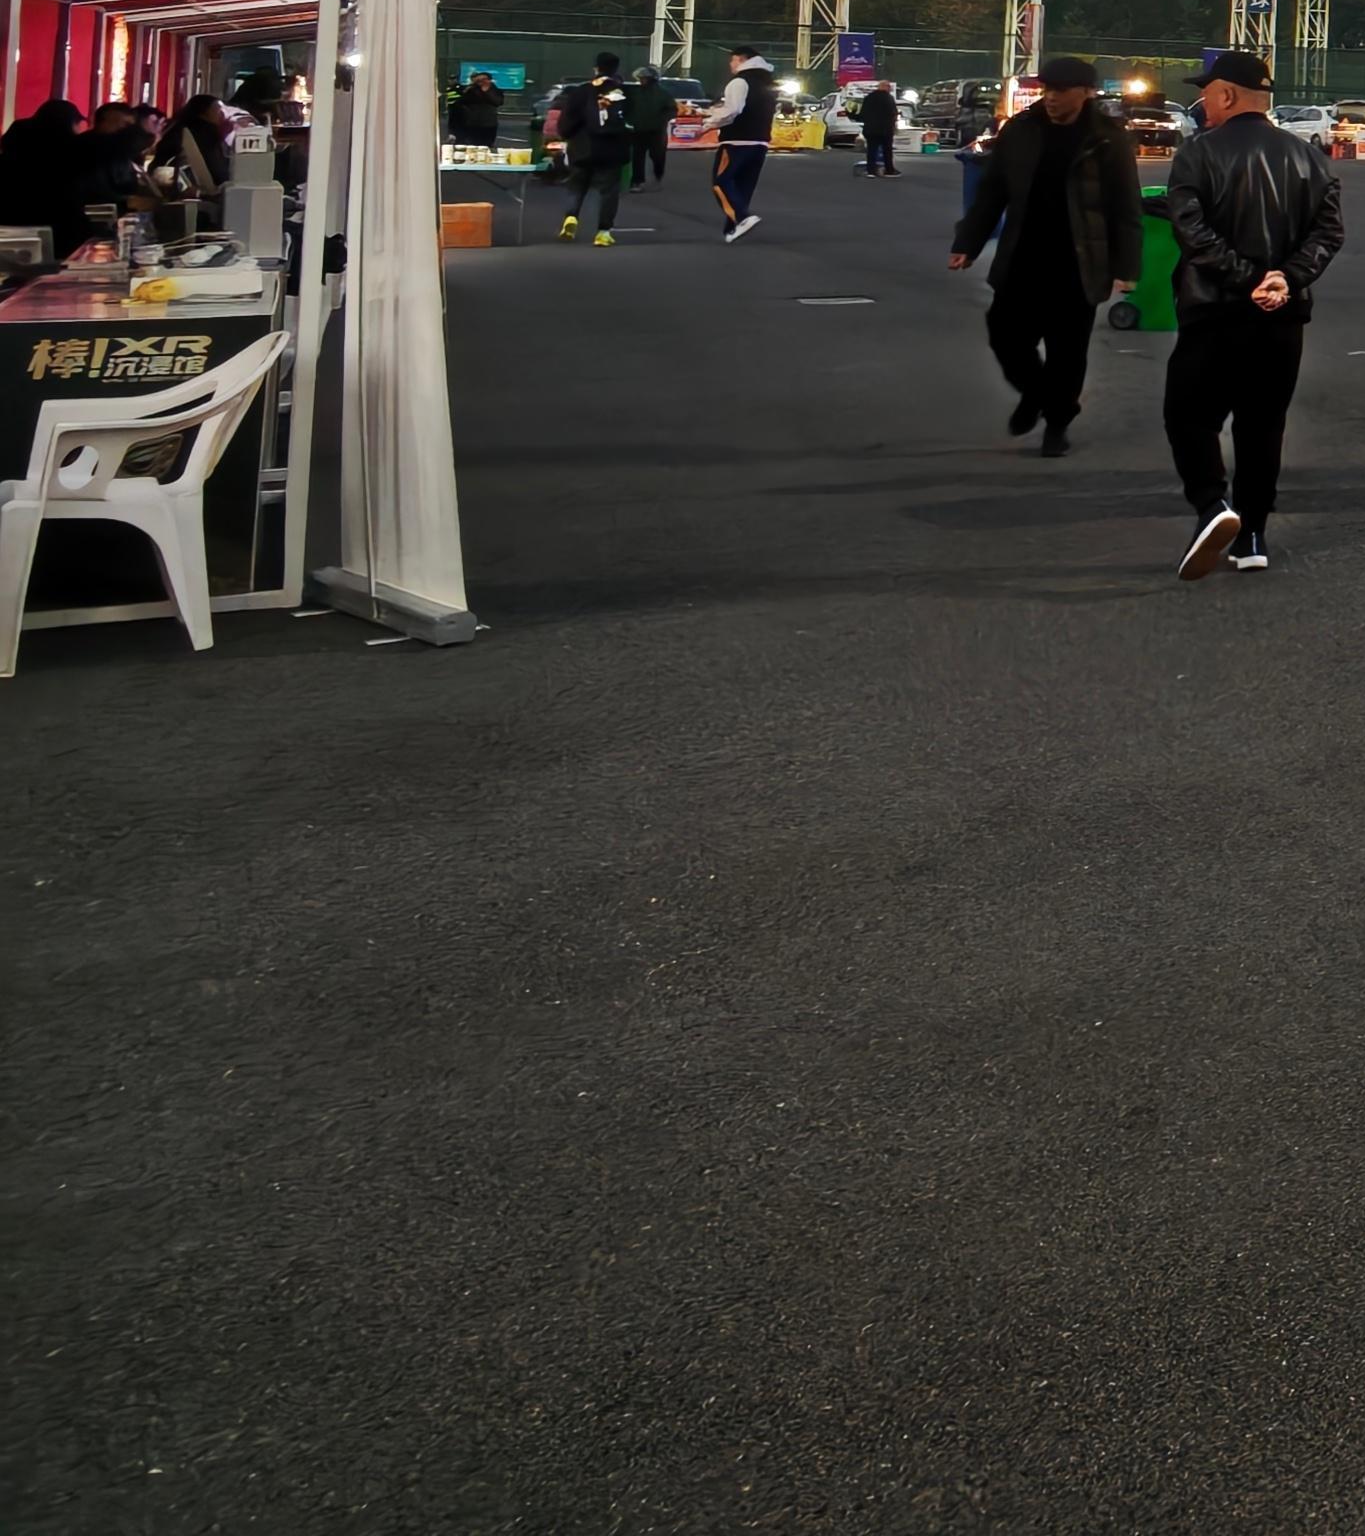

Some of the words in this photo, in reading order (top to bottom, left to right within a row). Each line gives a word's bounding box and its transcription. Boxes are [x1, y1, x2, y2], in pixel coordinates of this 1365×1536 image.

[110, 335, 213, 356] XR
[103, 355, 208, 377] 沉浸馆
